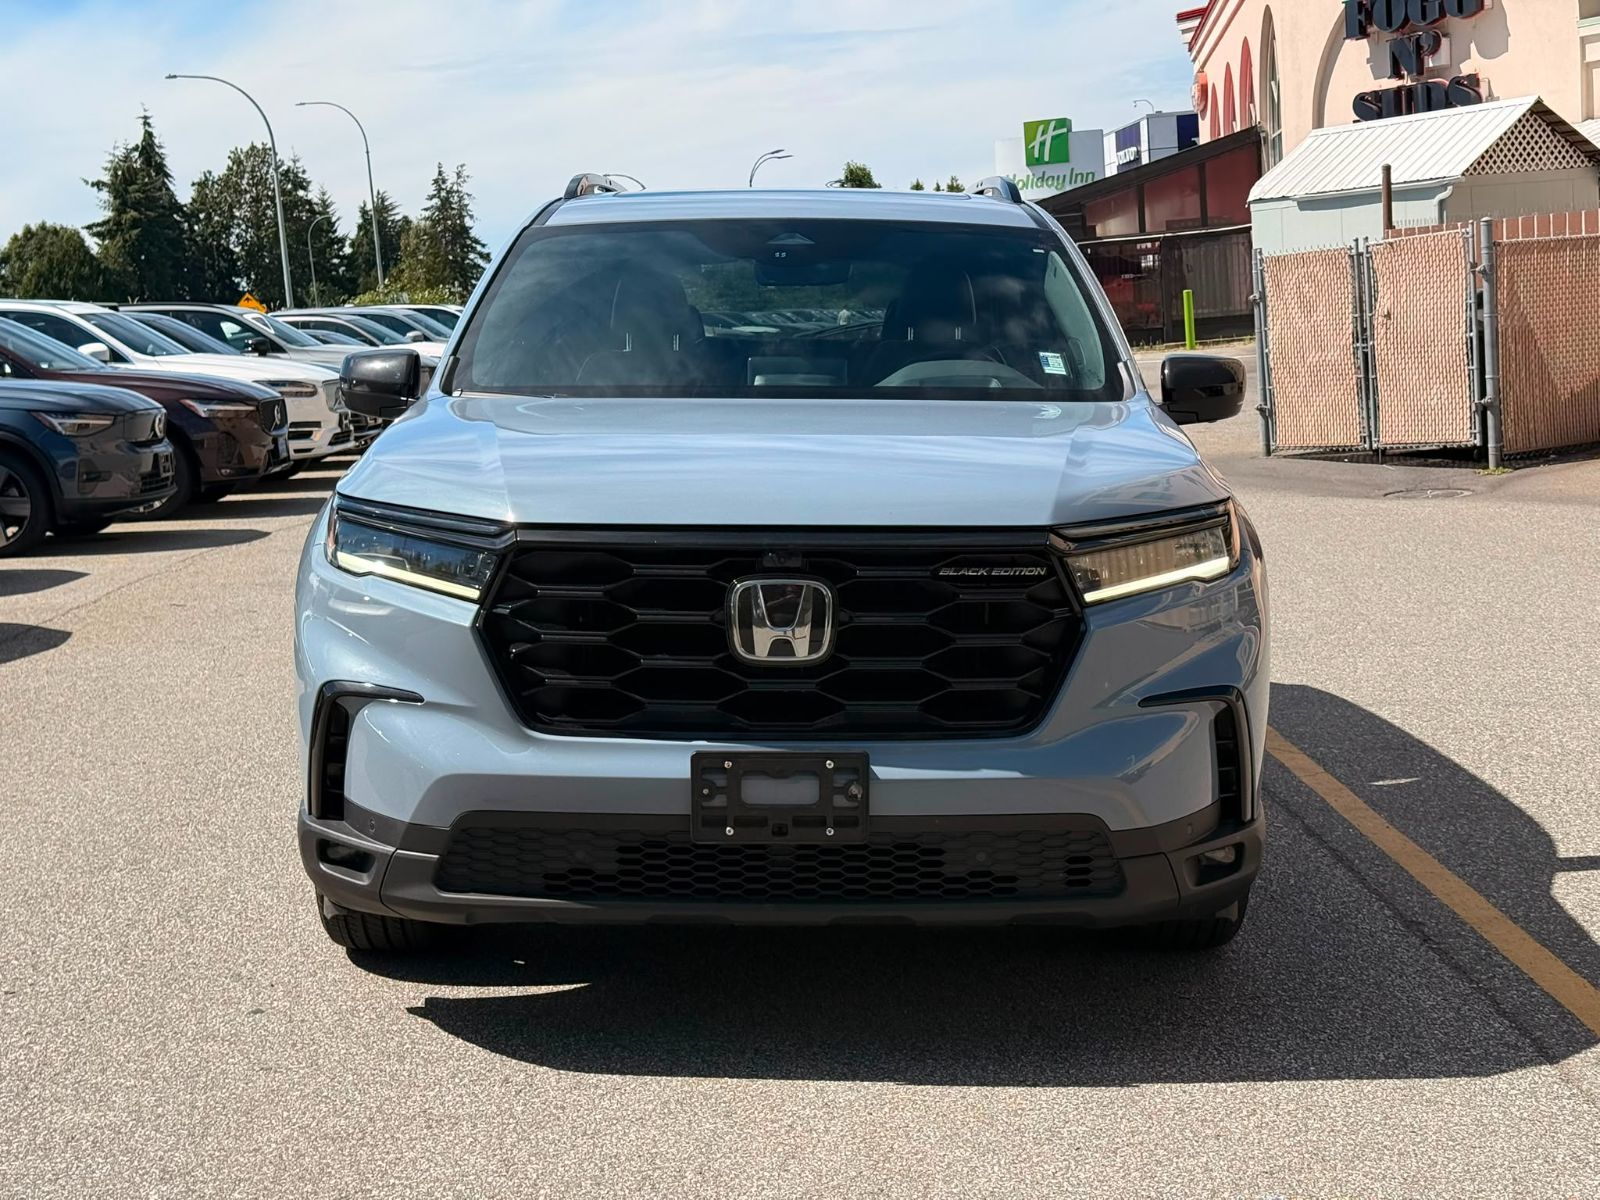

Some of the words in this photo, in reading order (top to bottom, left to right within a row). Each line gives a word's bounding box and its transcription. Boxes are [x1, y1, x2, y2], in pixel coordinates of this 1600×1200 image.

[1353, 73, 1482, 122] SUDS
[1069, 167, 1095, 184] Inn
[939, 567, 989, 575] BLACK
[991, 567, 1046, 575] EDITION
